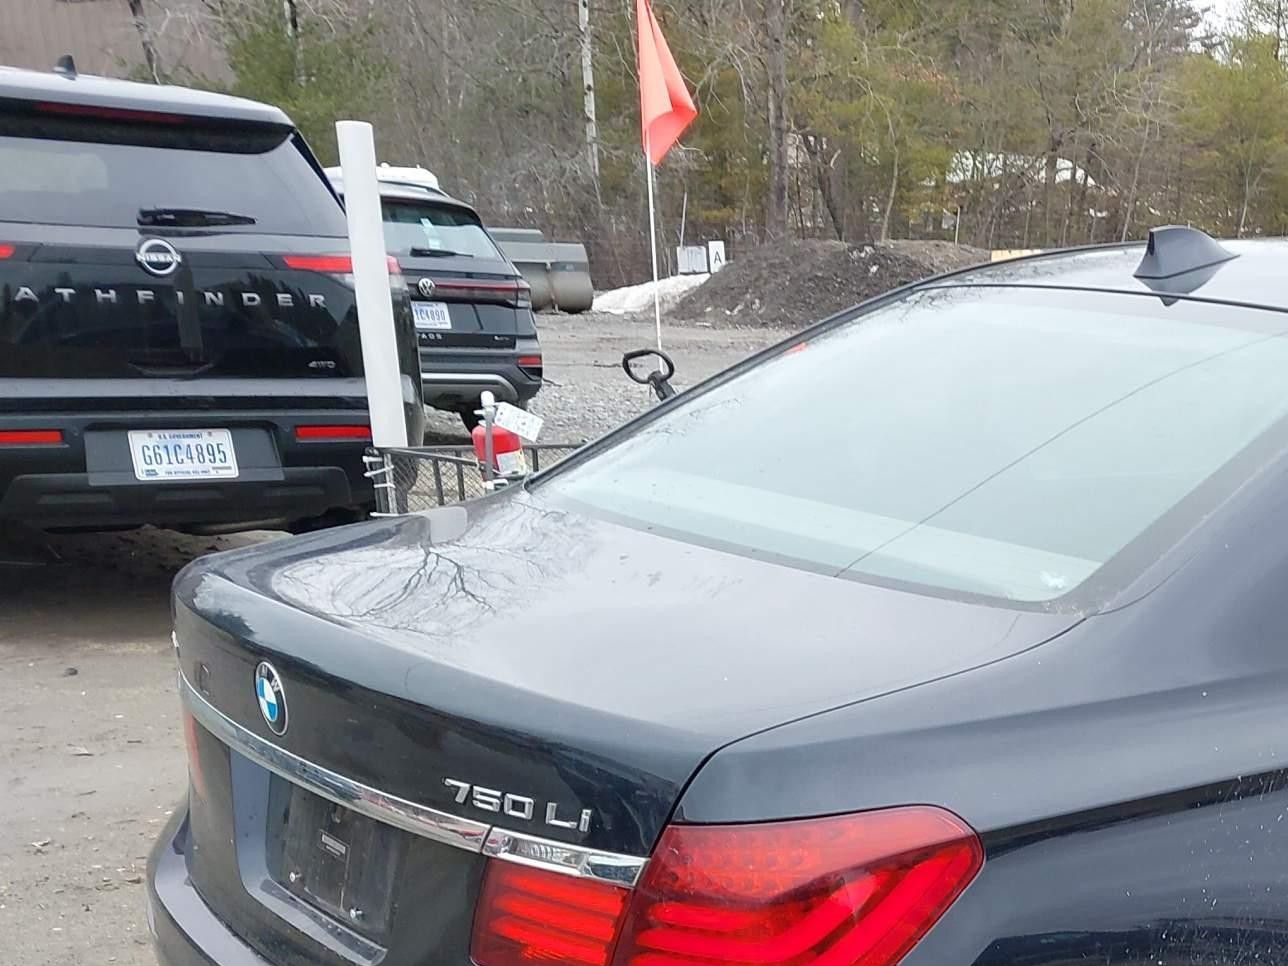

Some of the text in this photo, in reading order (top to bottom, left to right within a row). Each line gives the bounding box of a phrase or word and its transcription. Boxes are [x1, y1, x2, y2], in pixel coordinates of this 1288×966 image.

[136, 251, 182, 263] NISSAN
[713, 250, 723, 264] A
[14, 286, 327, 308] ATHFINDER
[141, 442, 227, 466] G61C4895
[443, 778, 592, 832] 750 Li
